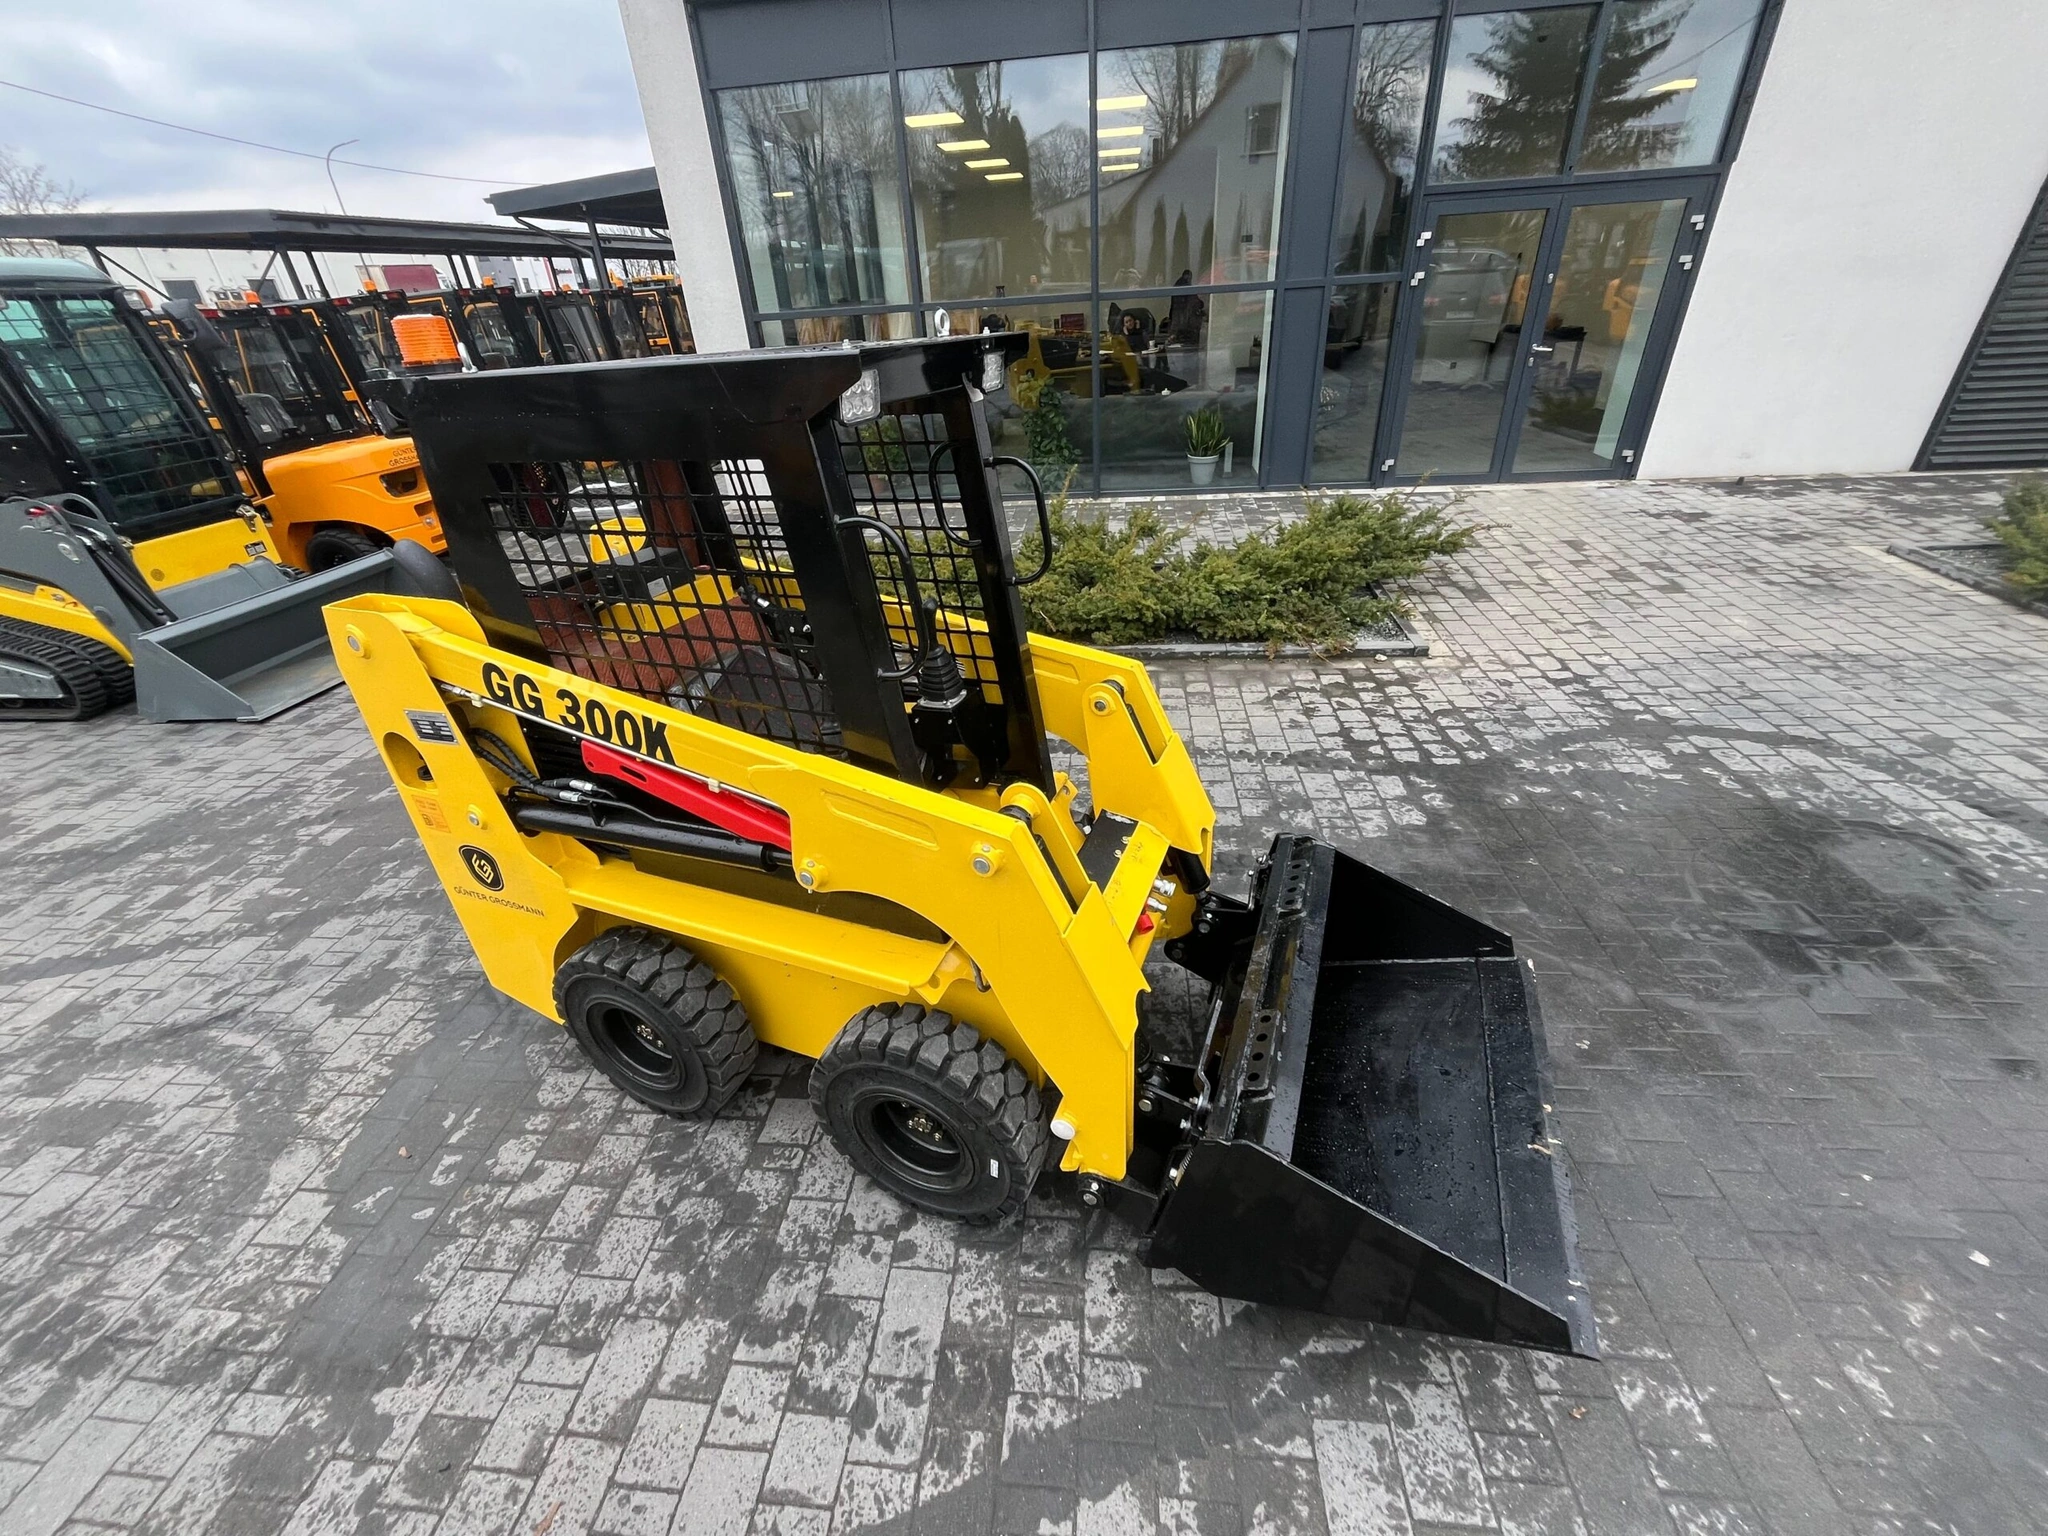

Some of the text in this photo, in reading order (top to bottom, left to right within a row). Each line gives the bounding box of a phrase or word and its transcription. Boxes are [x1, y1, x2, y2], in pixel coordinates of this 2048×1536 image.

[482, 662, 677, 766] GG 300K
[453, 886, 545, 917] GÜNTER GROSSMANN
